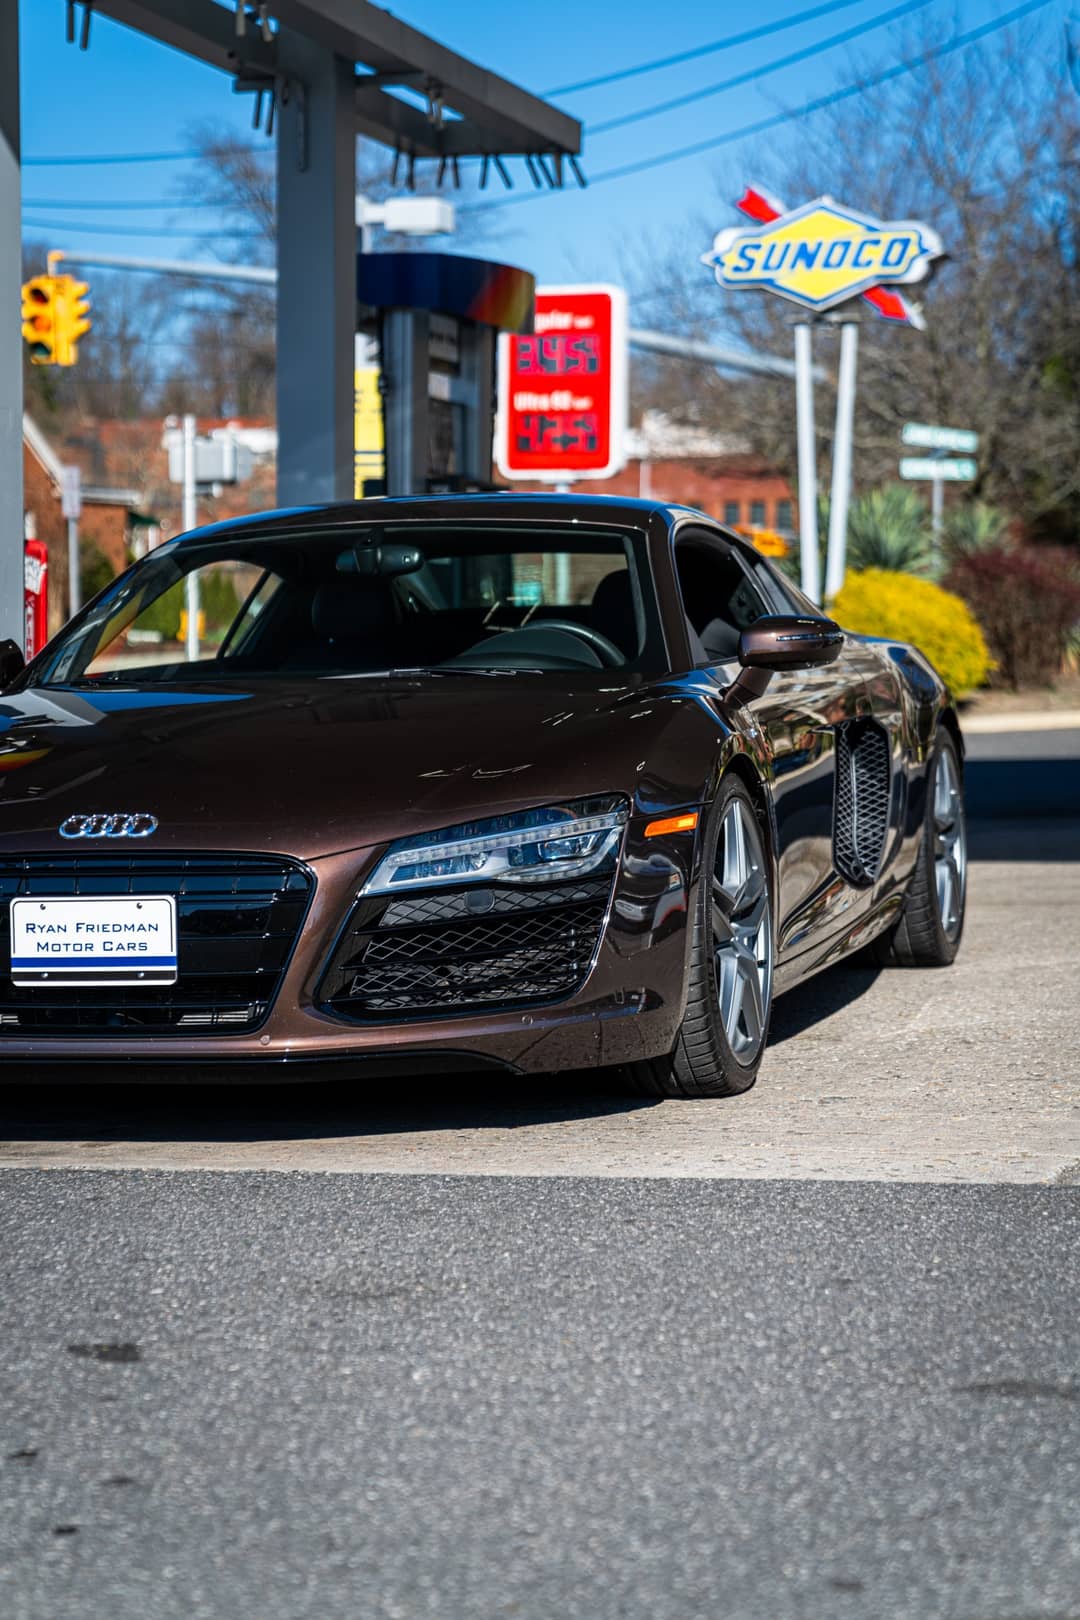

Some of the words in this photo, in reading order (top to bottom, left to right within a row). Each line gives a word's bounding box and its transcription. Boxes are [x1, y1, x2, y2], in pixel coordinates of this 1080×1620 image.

[732, 237, 911, 272] SUNOCO
[25, 923, 67, 934] RYAN
[76, 922, 159, 933] FRIEDMAN
[36, 941, 94, 952] MOTOR
[103, 941, 148, 951] CARS
